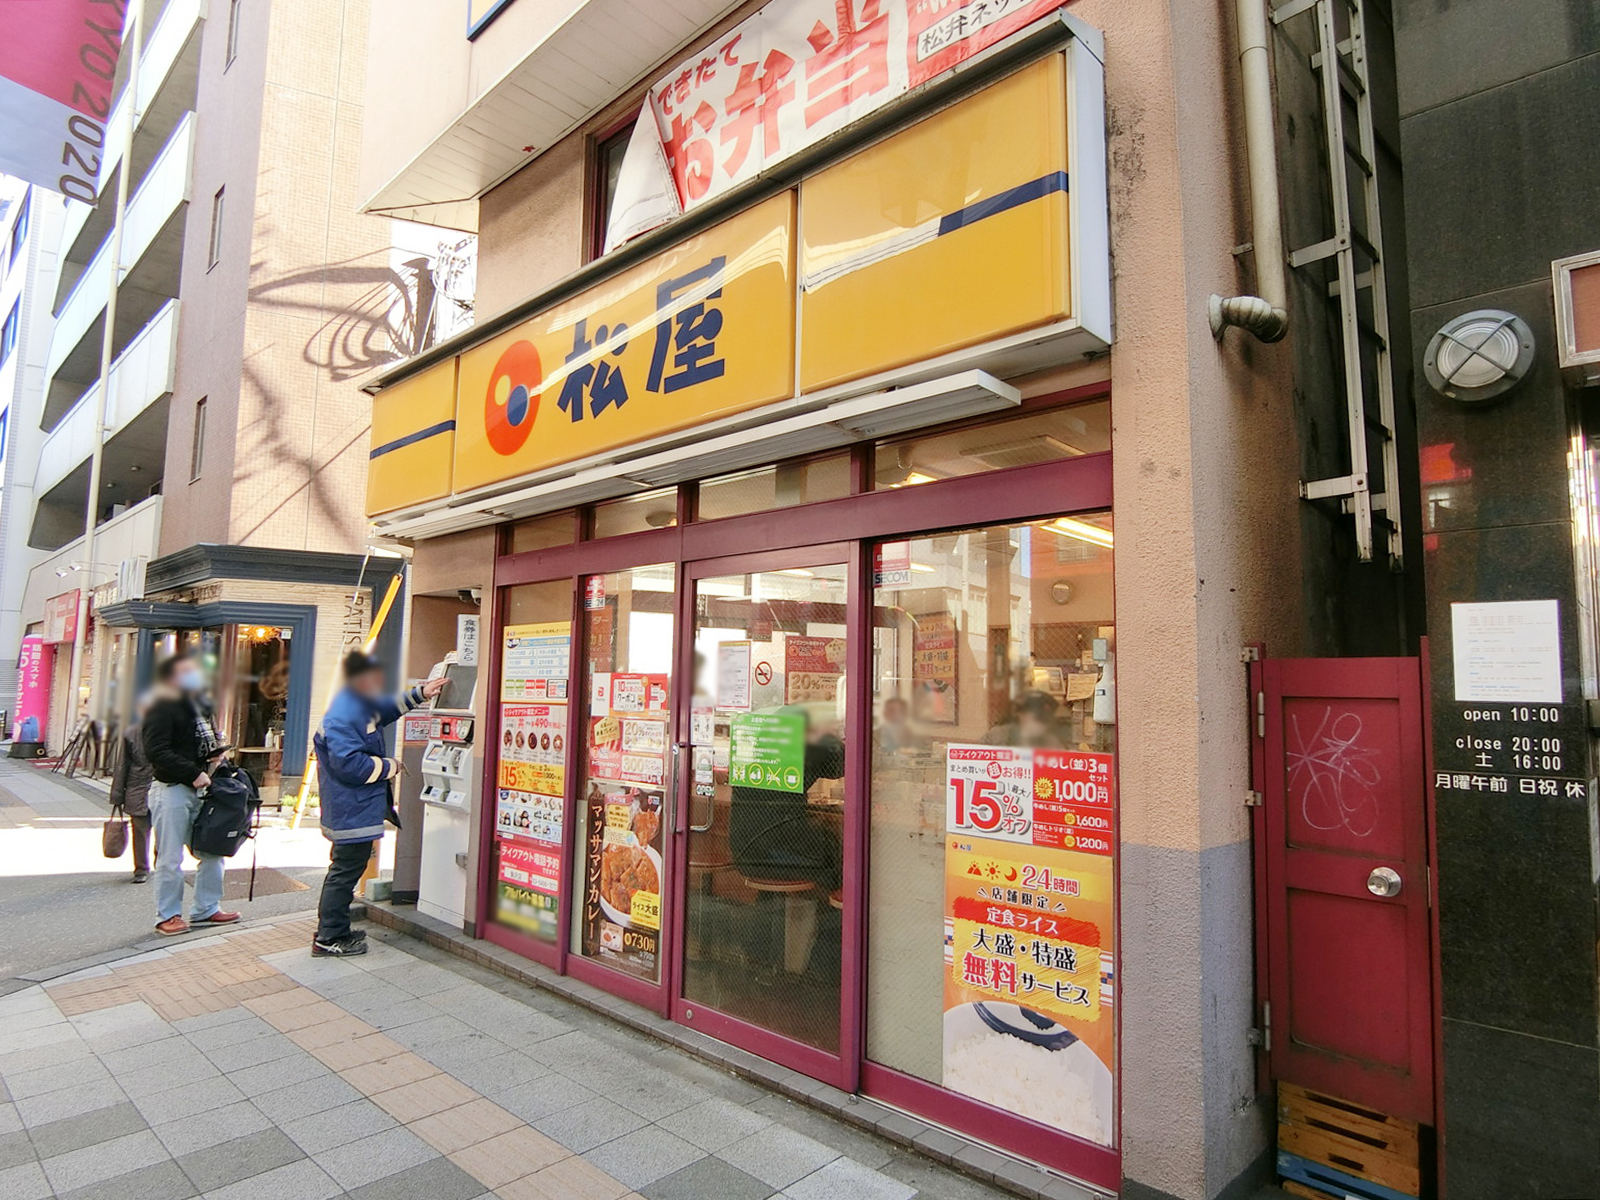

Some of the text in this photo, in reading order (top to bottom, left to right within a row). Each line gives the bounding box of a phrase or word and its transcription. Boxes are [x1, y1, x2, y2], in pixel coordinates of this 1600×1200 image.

[921, 0, 1030, 54] 松弁ネッ
[656, 34, 743, 117] できたて
[662, 0, 891, 210] お弁当
[556, 254, 728, 424] 松屋
[874, 571, 909, 584] SECOM
[463, 618, 477, 662] 食券はこちら
[1463, 707, 1559, 722] open 10:00
[1456, 734, 1561, 753] close 20:00
[623, 757, 644, 772] 300
[1474, 752, 1562, 771] 土 16:00
[504, 765, 517, 787] 15
[1089, 774, 1108, 783] セット
[1435, 774, 1586, 799] 月曜午前 日祝 休
[1011, 784, 1027, 798] 最大
[950, 777, 1002, 830] 15
[1003, 816, 1028, 832] オフ
[501, 845, 560, 870] テイクアウト電話予約
[586, 803, 604, 940] マッサマンカレー
[1021, 865, 1080, 896] 24時間
[632, 901, 659, 917] ライス大盛
[991, 886, 1050, 911] 店舗限定
[986, 906, 1059, 935] 定食ライス
[972, 928, 1078, 972] 大盛・特盛
[962, 951, 1091, 1008] 無料サービス
